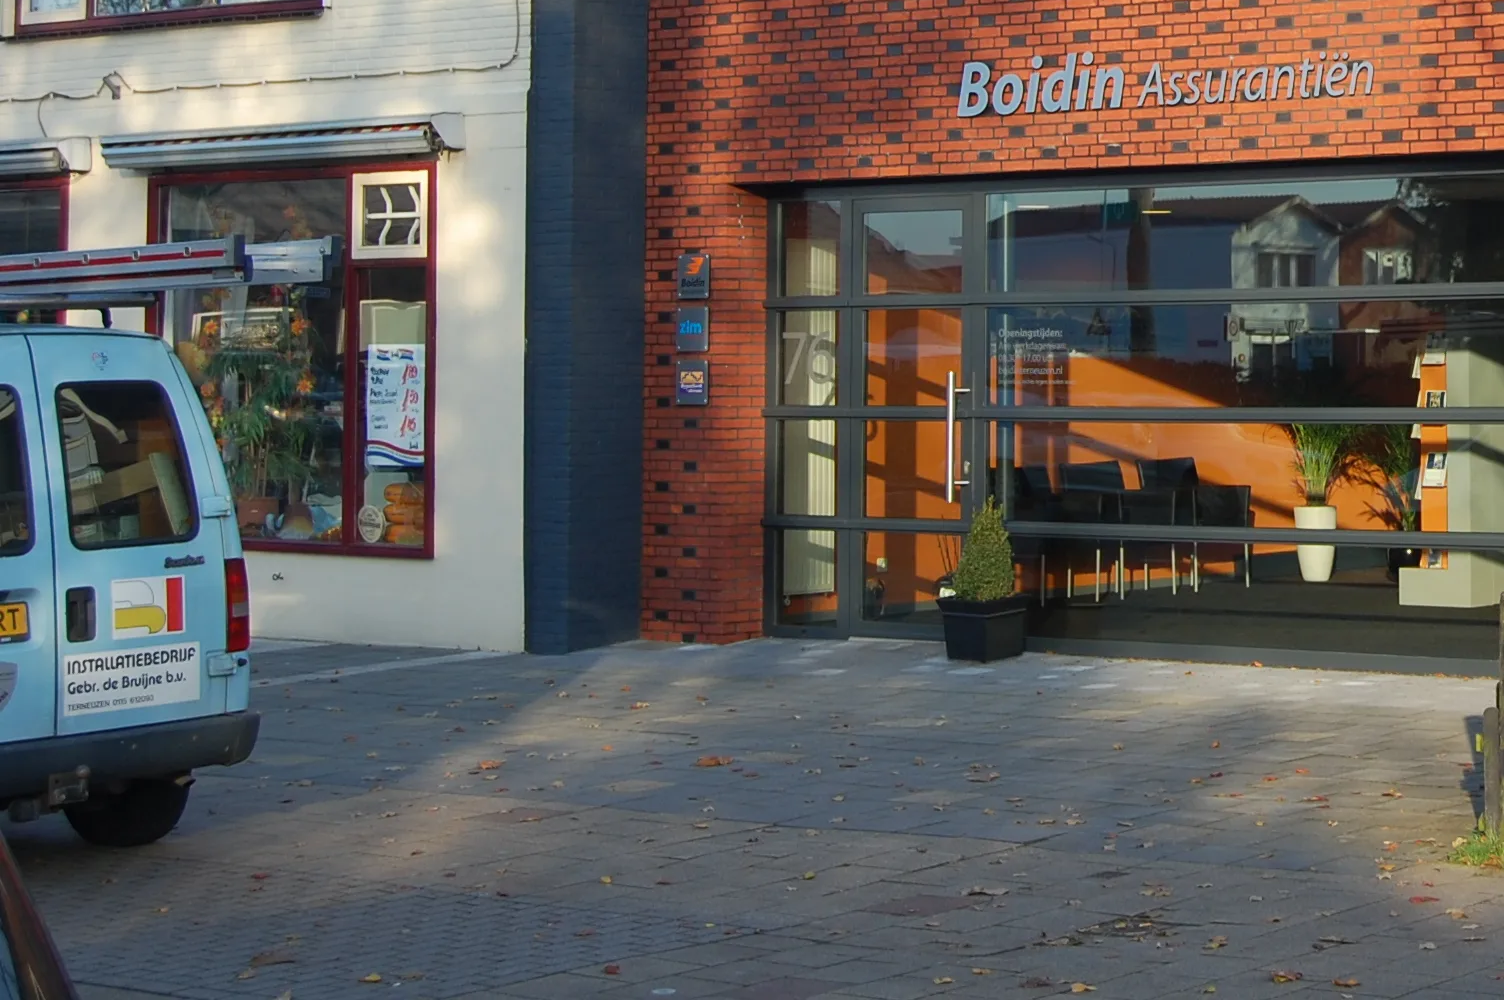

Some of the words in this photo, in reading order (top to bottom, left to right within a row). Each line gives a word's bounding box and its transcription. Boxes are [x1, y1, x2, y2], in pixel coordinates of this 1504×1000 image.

[957, 51, 1125, 117] Boidin
[1137, 51, 1375, 107] Assurantiën
[782, 331, 834, 385] 76
[67, 647, 196, 675] INSTALLATIEBEDRIJF
[67, 681, 100, 695] Gebr.
[102, 678, 118, 691] de
[122, 673, 163, 690] Bruijne
[166, 671, 187, 683] b.v.
